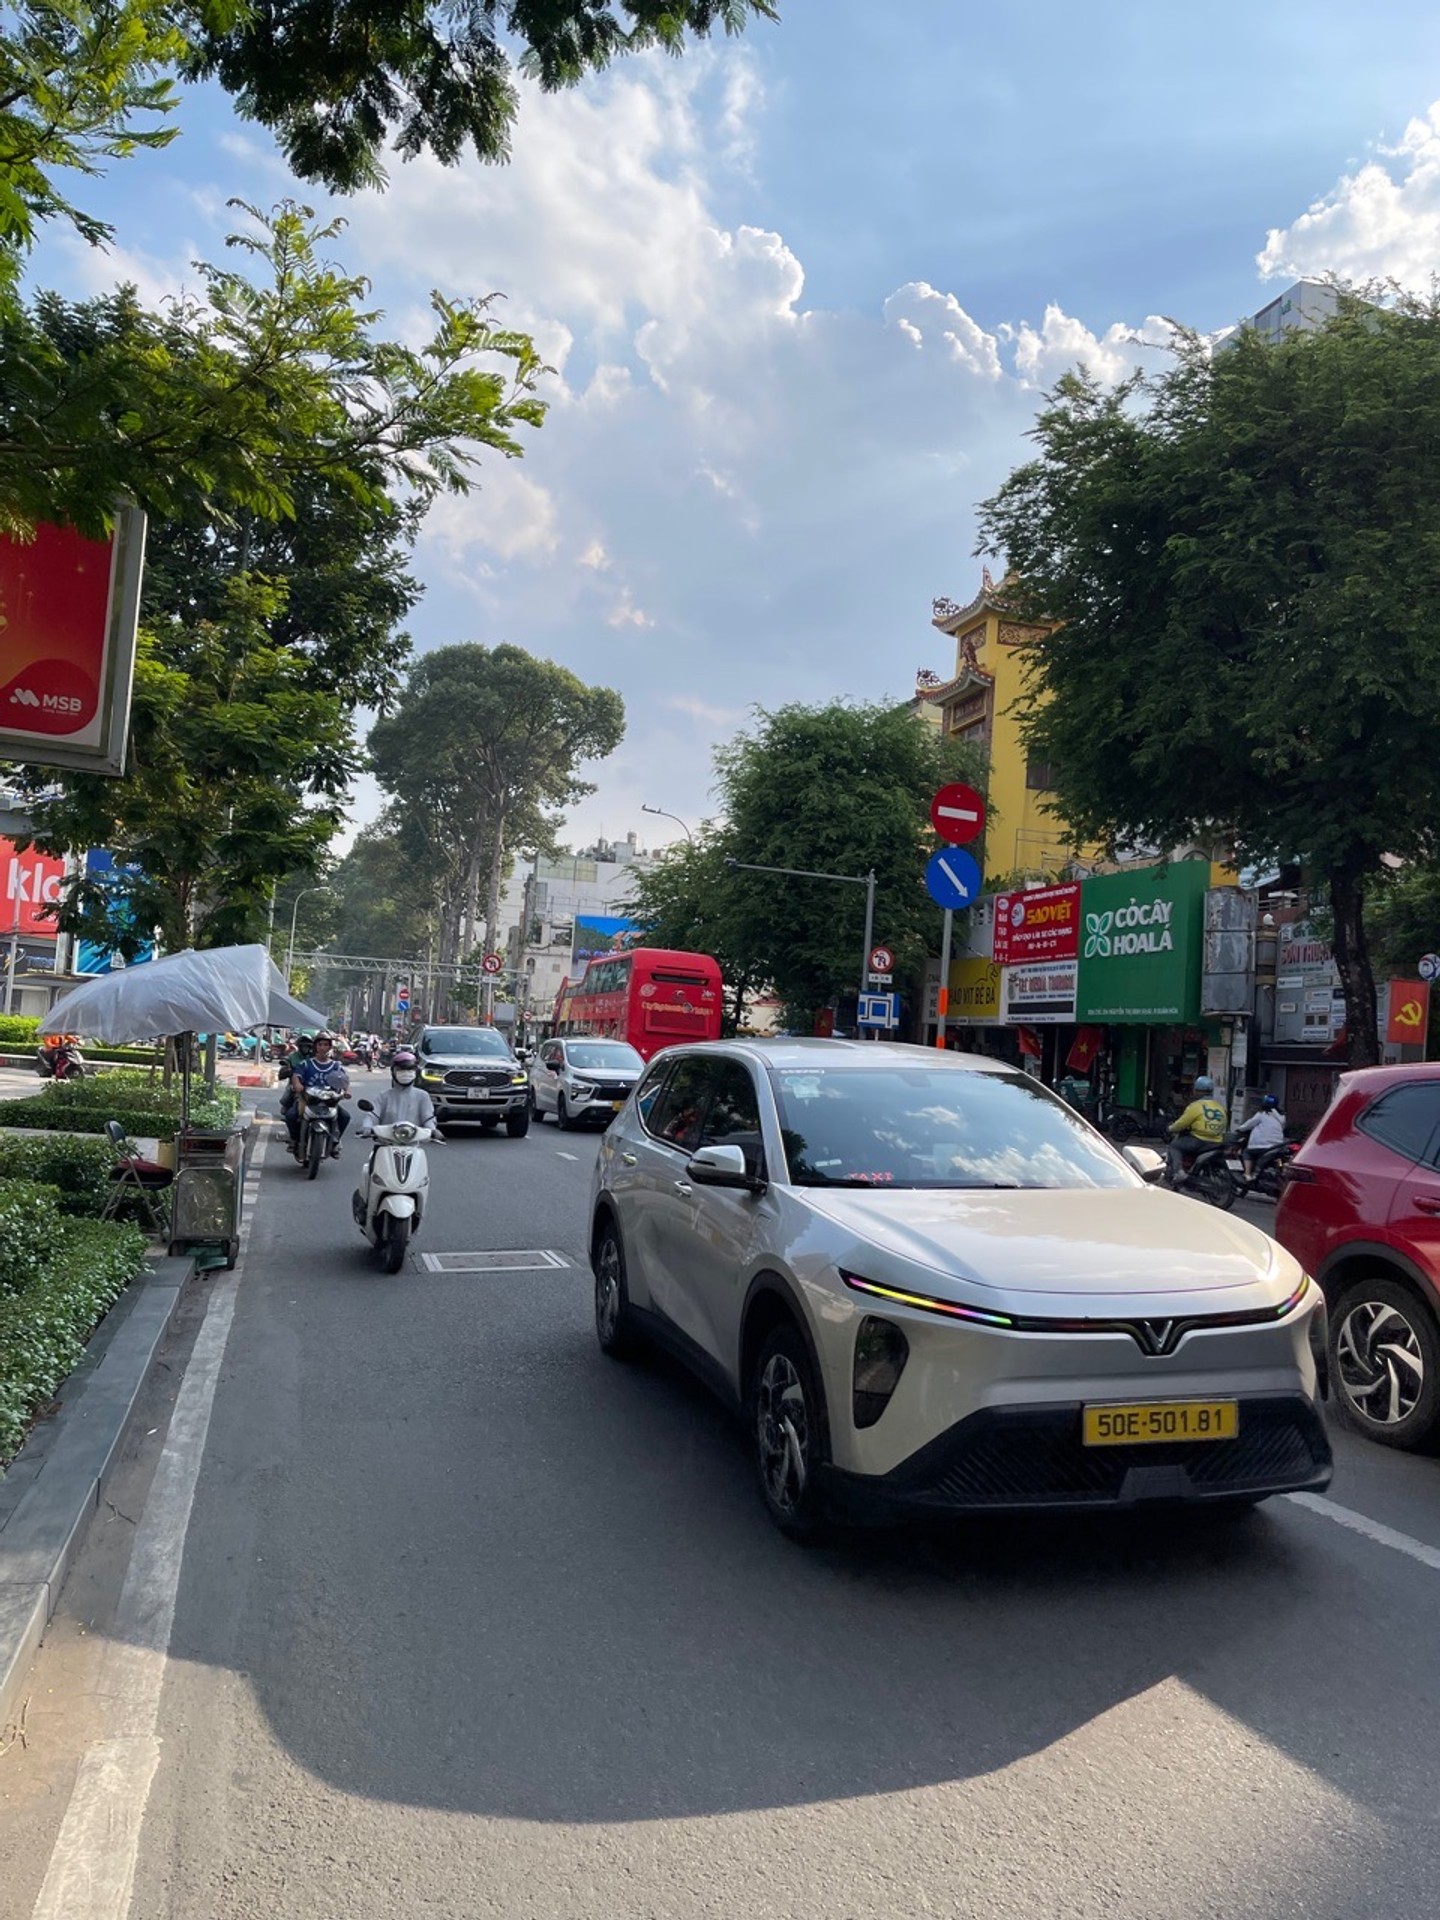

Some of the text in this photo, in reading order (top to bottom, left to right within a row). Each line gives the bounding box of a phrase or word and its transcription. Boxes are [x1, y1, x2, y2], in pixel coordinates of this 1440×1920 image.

[43, 694, 82, 712] MSB
[850, 1173, 892, 1181] TAXI
[1097, 1408, 1222, 1437] 50E-501.81
